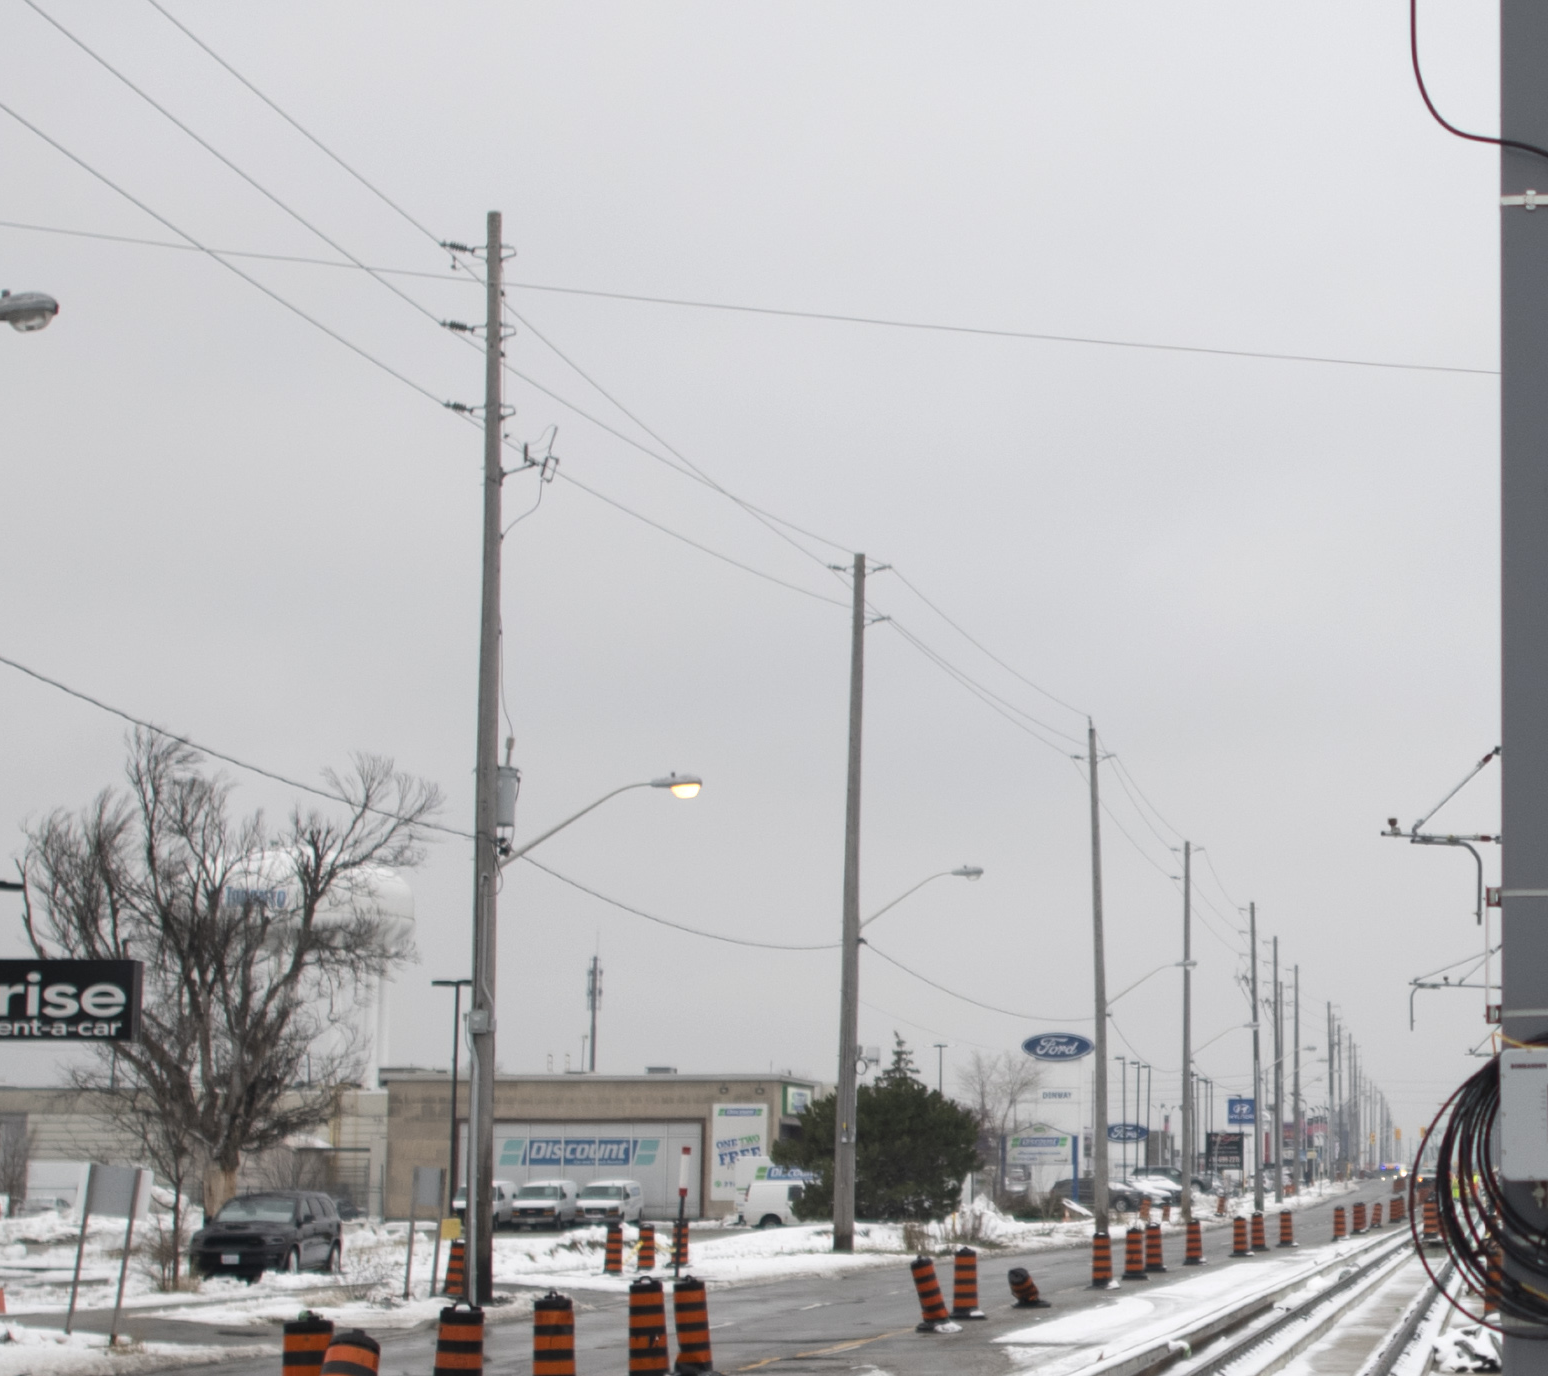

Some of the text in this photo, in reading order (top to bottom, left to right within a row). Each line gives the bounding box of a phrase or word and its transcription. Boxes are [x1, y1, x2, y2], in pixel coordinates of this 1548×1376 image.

[1036, 1037, 1079, 1055] Ford
[530, 1141, 629, 1160] Discount
[716, 1134, 761, 1150] ONE TWO
